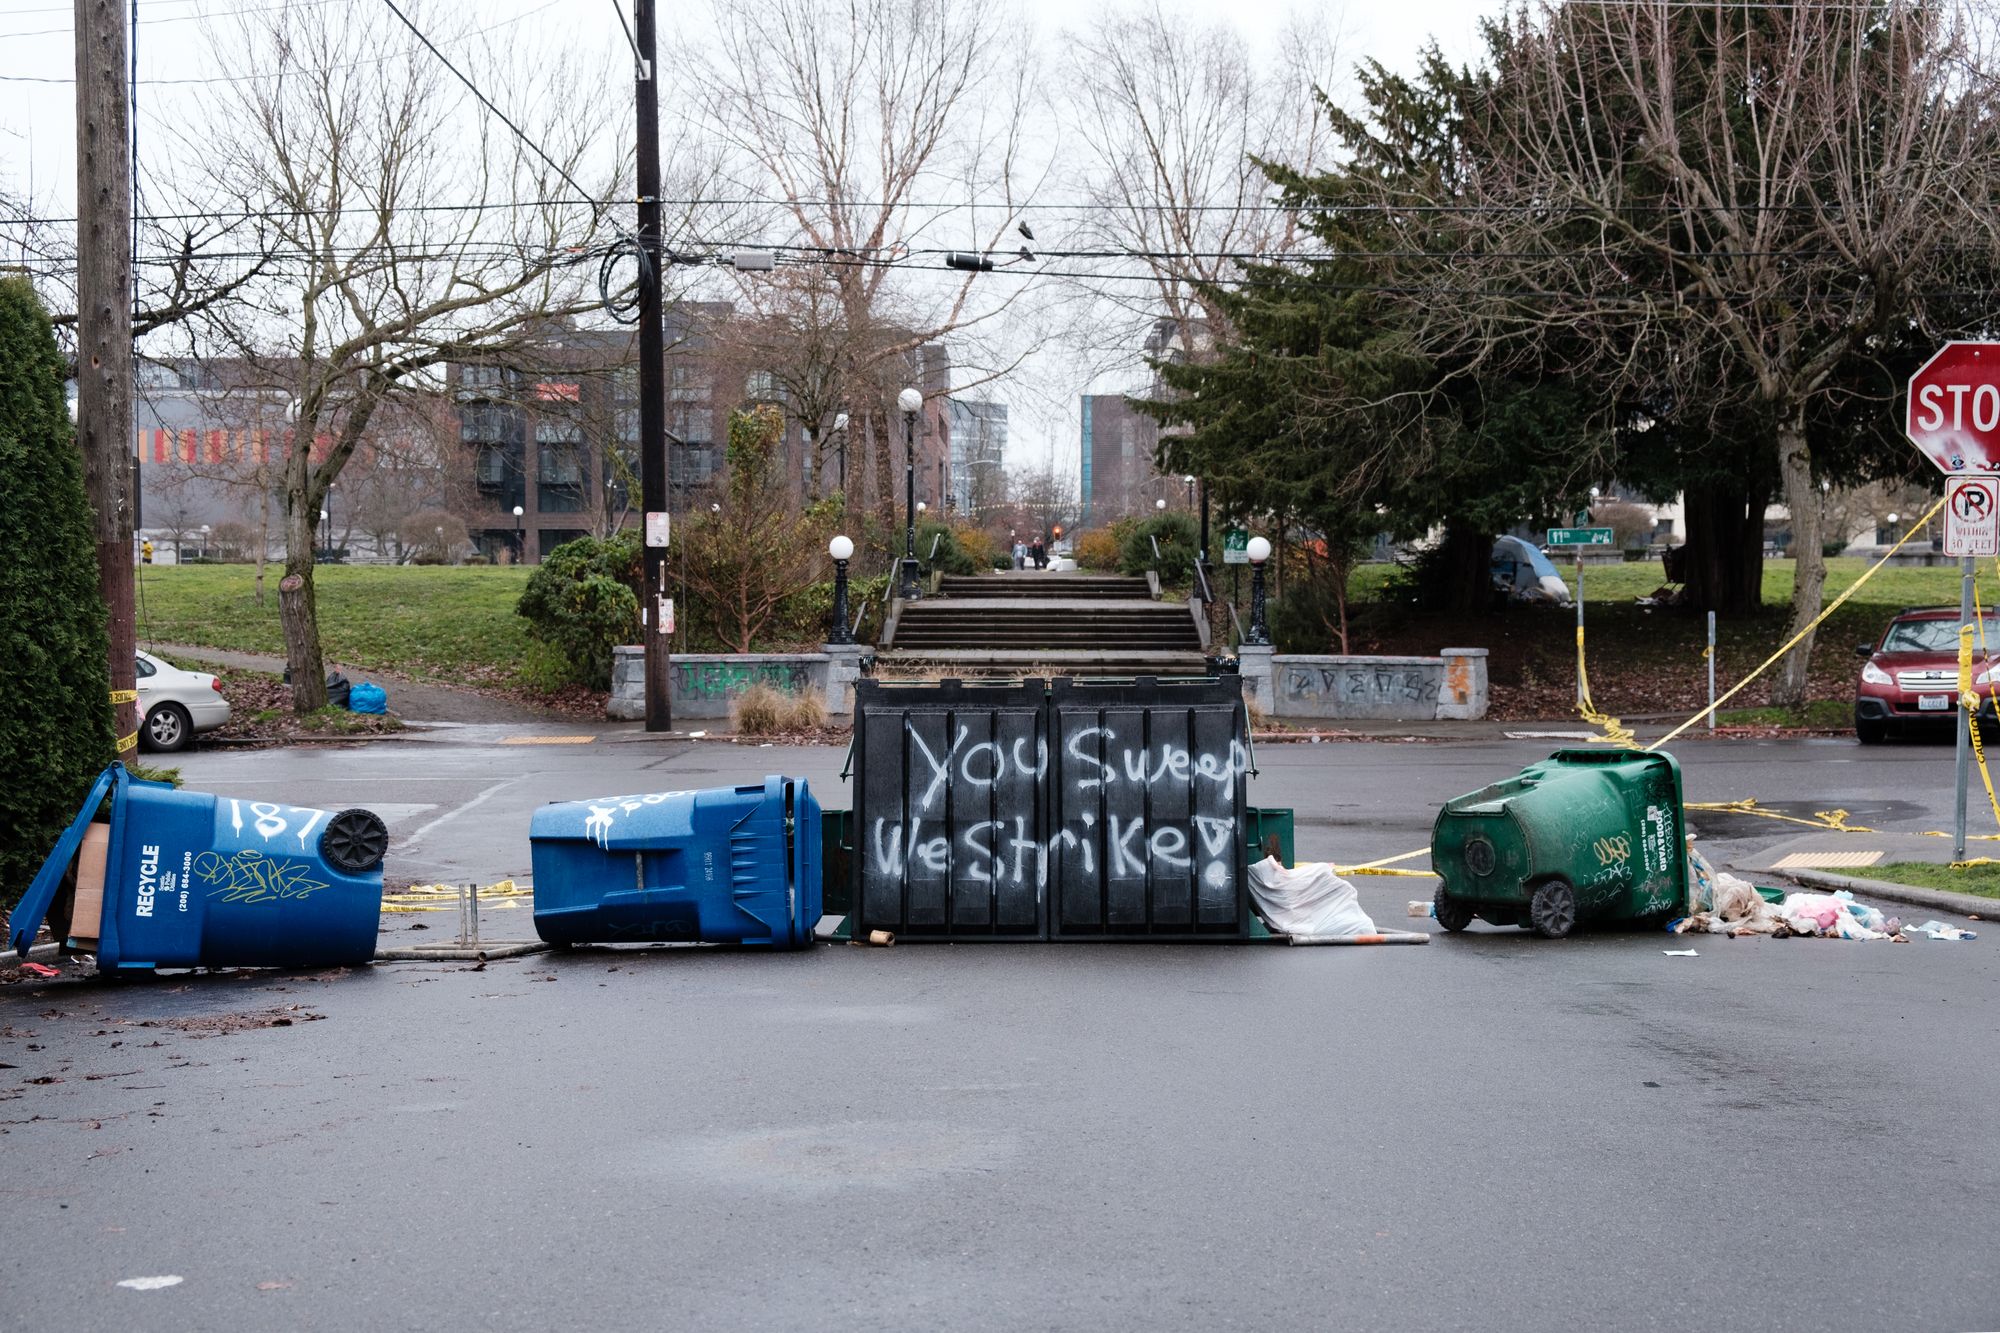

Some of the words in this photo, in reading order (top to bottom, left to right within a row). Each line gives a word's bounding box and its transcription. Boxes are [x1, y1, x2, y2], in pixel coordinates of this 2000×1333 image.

[1067, 726, 1247, 801] Sweep
[229, 799, 324, 848] 187
[874, 815, 948, 876] We
[136, 844, 160, 917] RECYCLE
[181, 851, 192, 889] 684-3000
[179, 890, 190, 912] (206)
